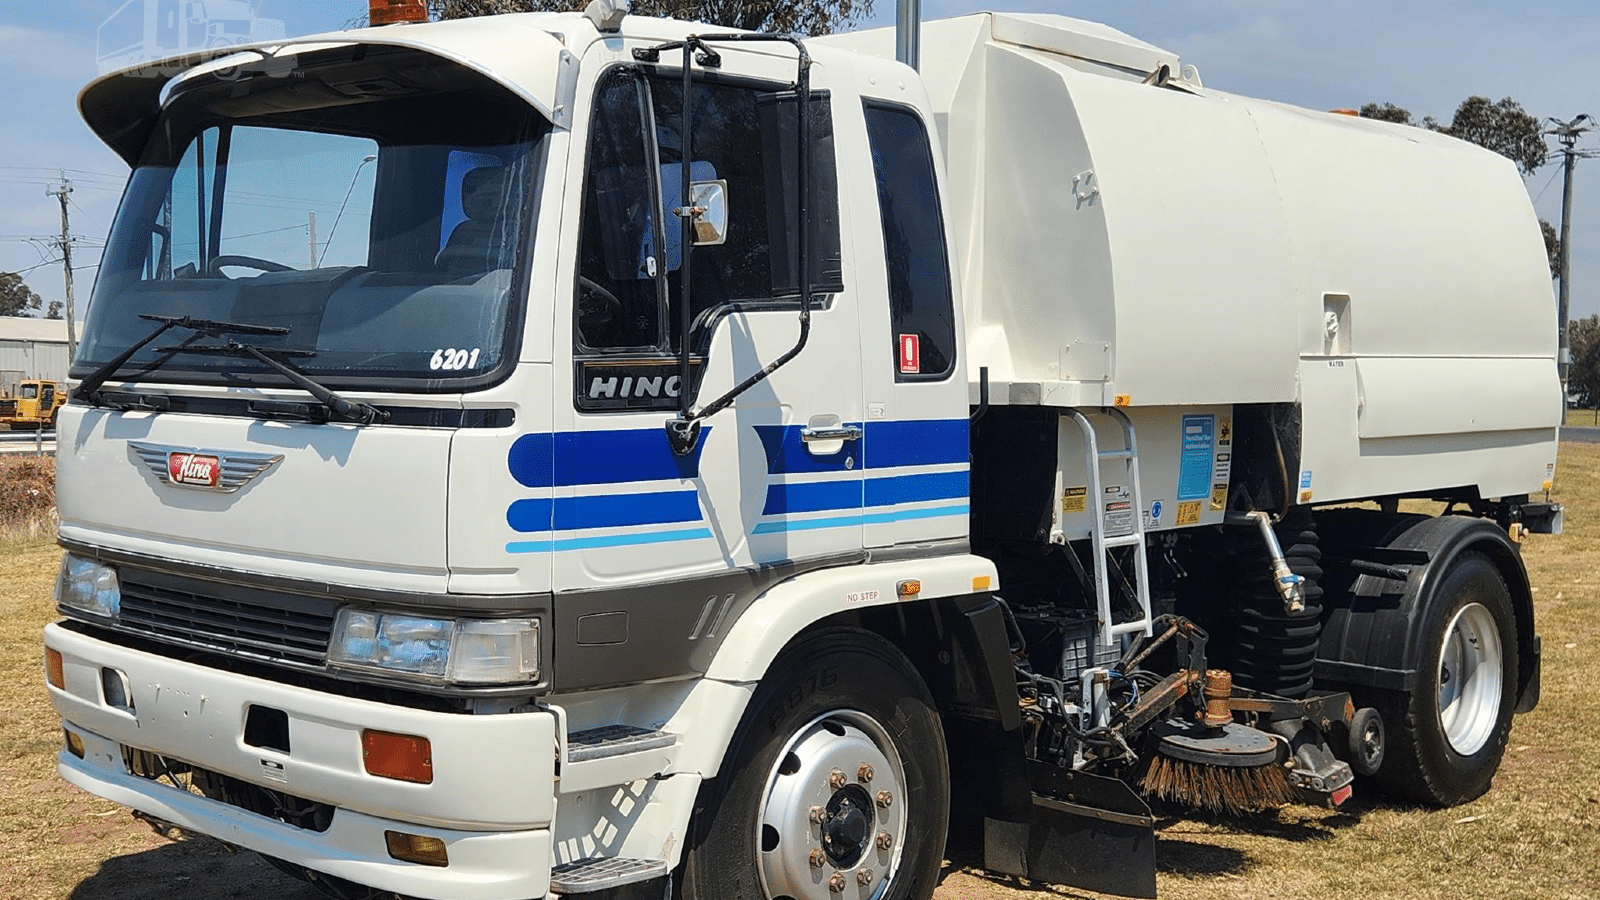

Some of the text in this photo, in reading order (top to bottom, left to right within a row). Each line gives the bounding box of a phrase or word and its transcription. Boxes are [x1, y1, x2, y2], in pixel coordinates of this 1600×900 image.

[430, 348, 480, 370] 6201
[176, 455, 213, 484] Hino
[847, 591, 879, 602] NO STEP
